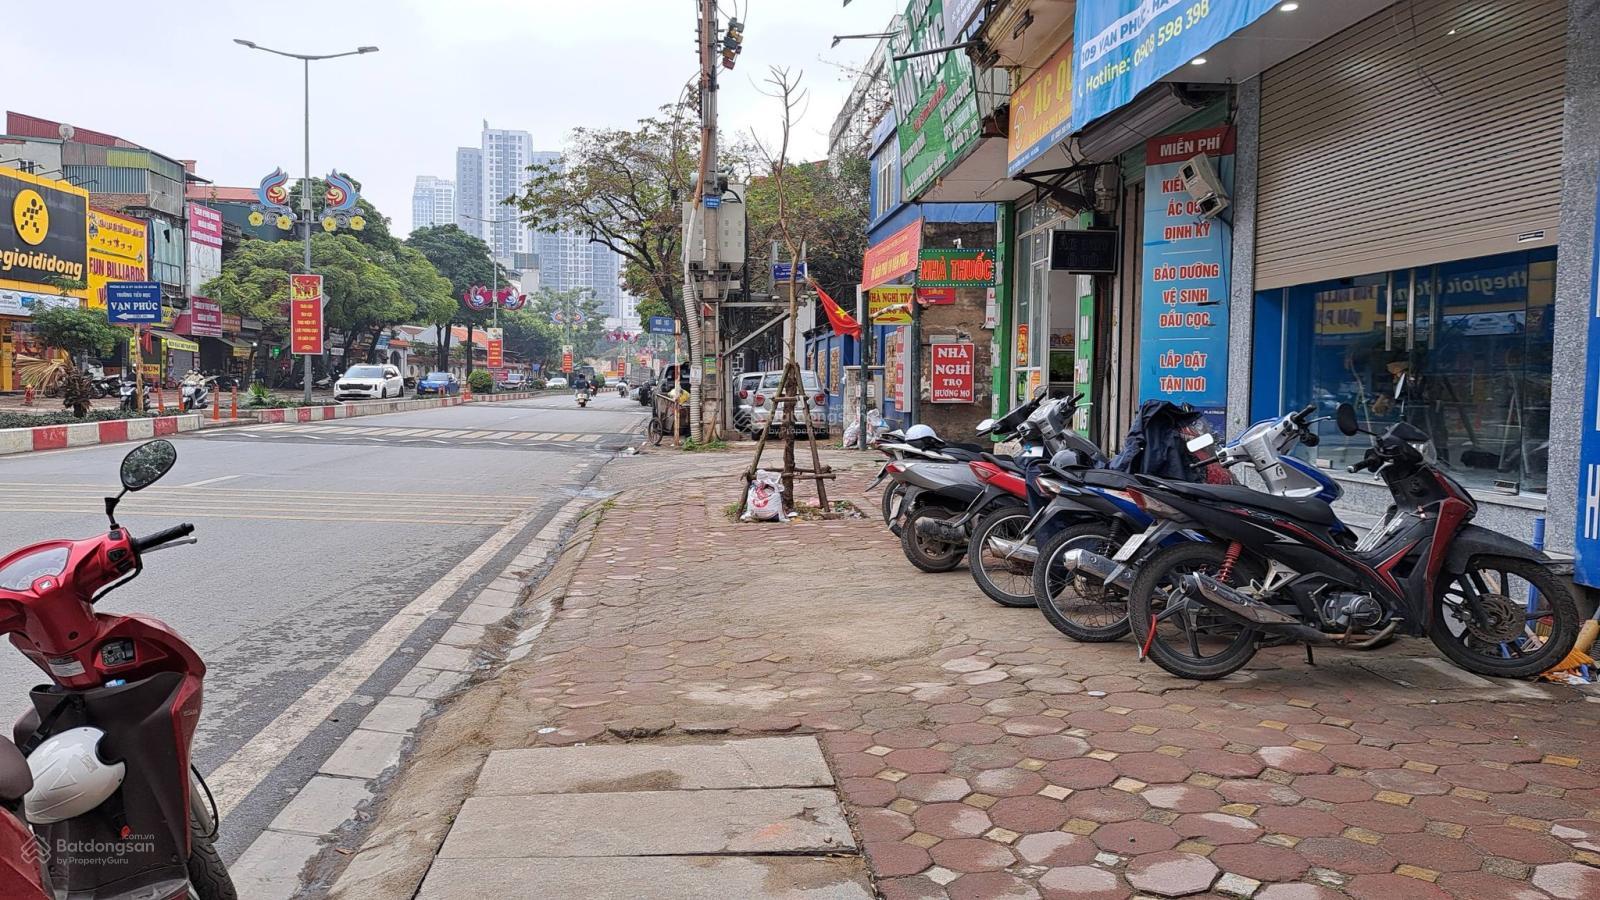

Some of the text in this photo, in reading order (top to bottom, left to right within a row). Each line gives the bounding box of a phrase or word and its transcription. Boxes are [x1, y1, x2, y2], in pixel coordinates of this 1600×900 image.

[1082, 46, 1096, 64] 109
[1100, 30, 1118, 52] VẠN
[1086, 1, 1209, 92] Hotline: 0908 598 398
[1160, 133, 1221, 157] MIỄN PHÍ
[1164, 224, 1192, 243] ĐỊNH
[0, 248, 83, 280] gioididong
[89, 257, 145, 281] FUN BILLIARDS
[921, 257, 947, 281] NHÀ
[950, 252, 993, 281] THUỐC
[1154, 261, 1219, 281] BẢO DƯỠNG
[111, 300, 158, 312] VẠN PHÚC
[1163, 288, 1208, 307] VỆ SINH
[1185, 311, 1209, 328] CỌC
[938, 345, 968, 358] NHÀ
[1160, 350, 1206, 369] LẮP ĐẶT
[935, 361, 970, 375] NGHỈ
[942, 378, 963, 388] TRỌ
[1160, 375, 1206, 394] TẬN NƠI
